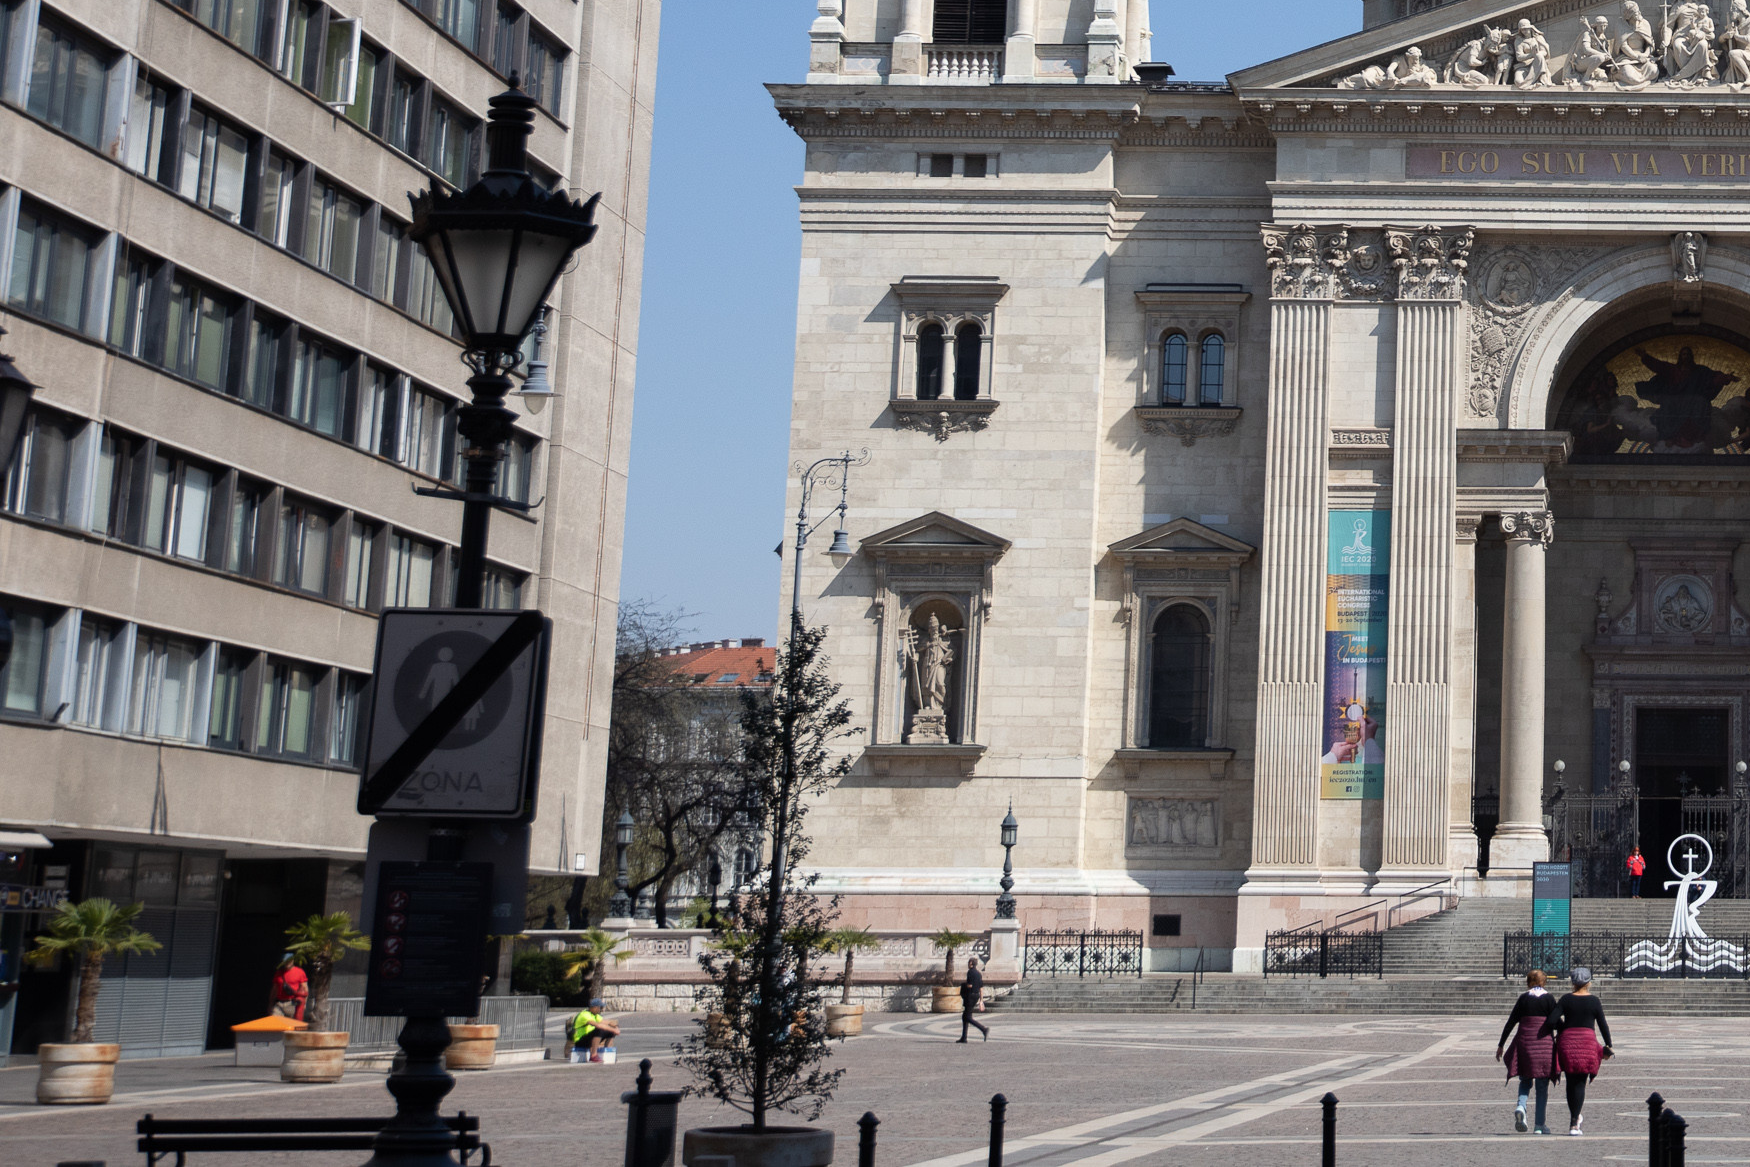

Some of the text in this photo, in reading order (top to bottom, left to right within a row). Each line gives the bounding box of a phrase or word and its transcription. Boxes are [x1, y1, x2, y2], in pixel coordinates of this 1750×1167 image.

[1440, 151, 1499, 174] EGO
[1522, 152, 1586, 174] SUM
[1610, 153, 1661, 175] VIA
[1337, 634, 1376, 660] Jesus
